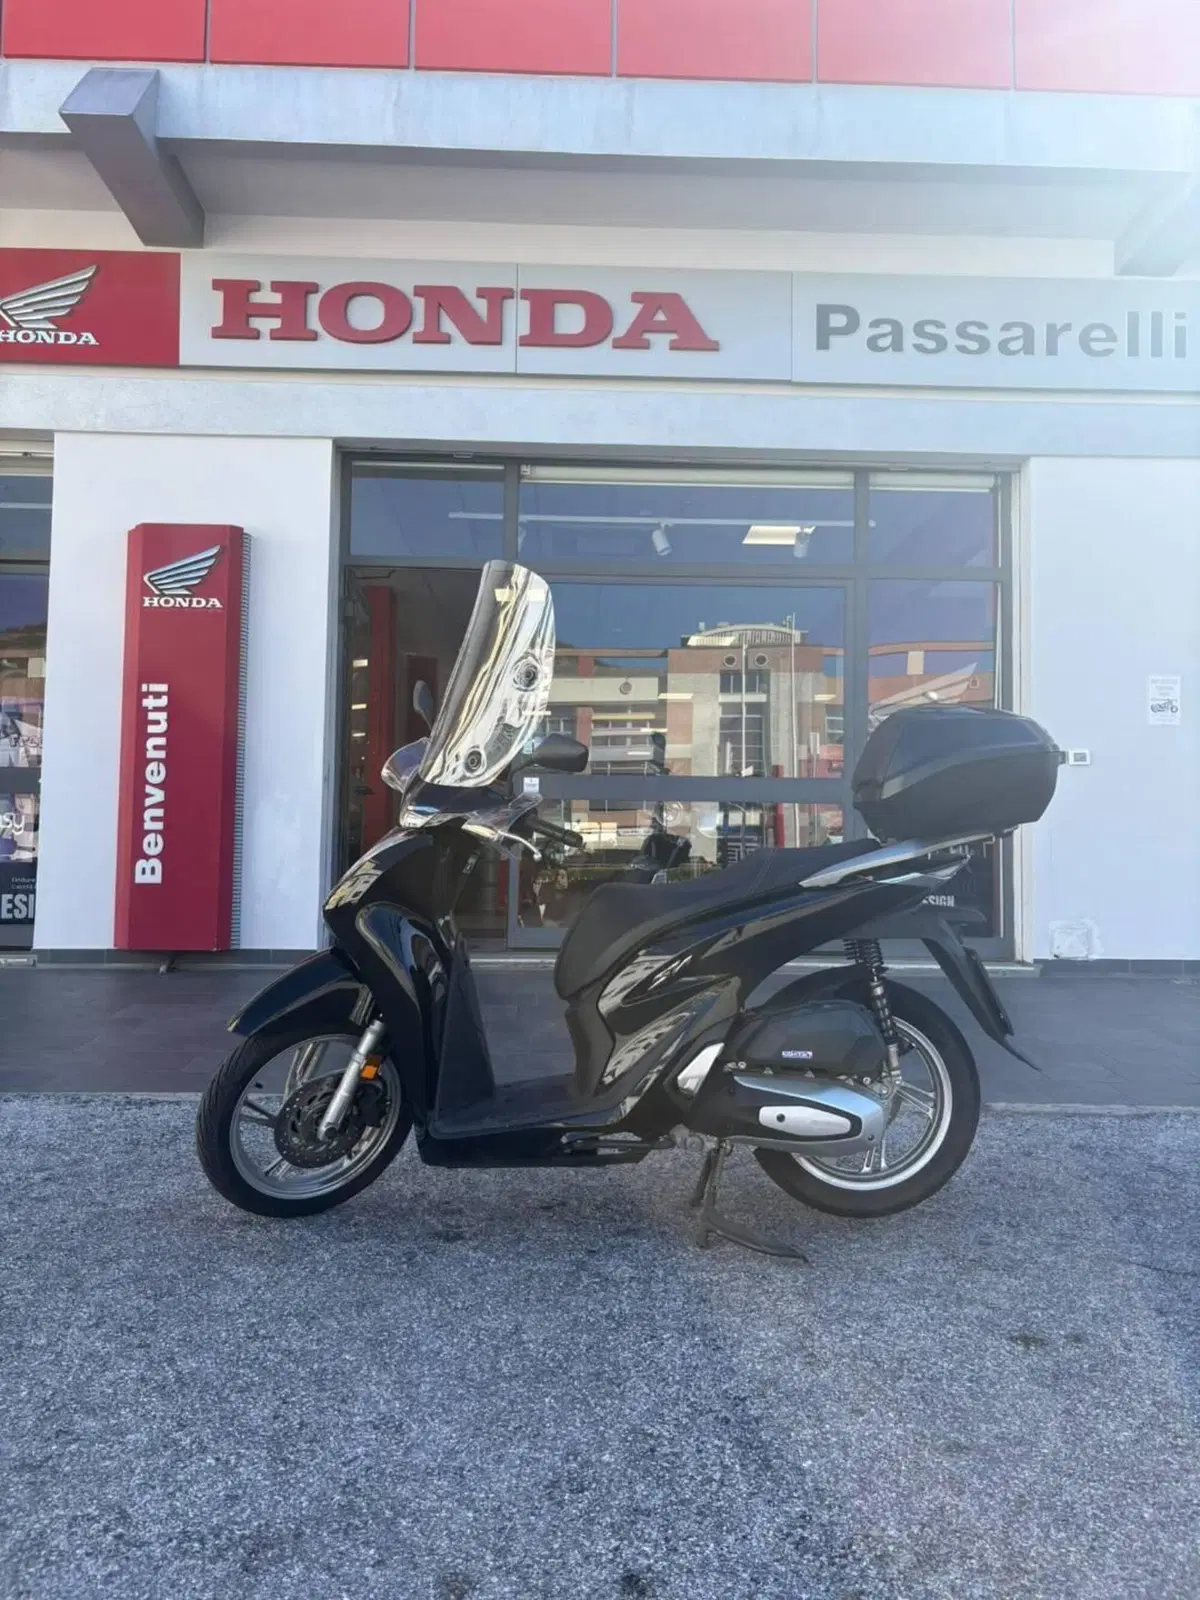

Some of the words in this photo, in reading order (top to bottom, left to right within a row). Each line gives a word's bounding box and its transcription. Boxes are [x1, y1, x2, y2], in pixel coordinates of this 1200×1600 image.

[211, 278, 720, 352] HONDA
[815, 303, 1188, 359] Passarelli
[0, 329, 100, 346] HONDA
[142, 596, 223, 609] HONDA
[134, 683, 169, 884] Benvenuti
[0, 811, 25, 836] sy
